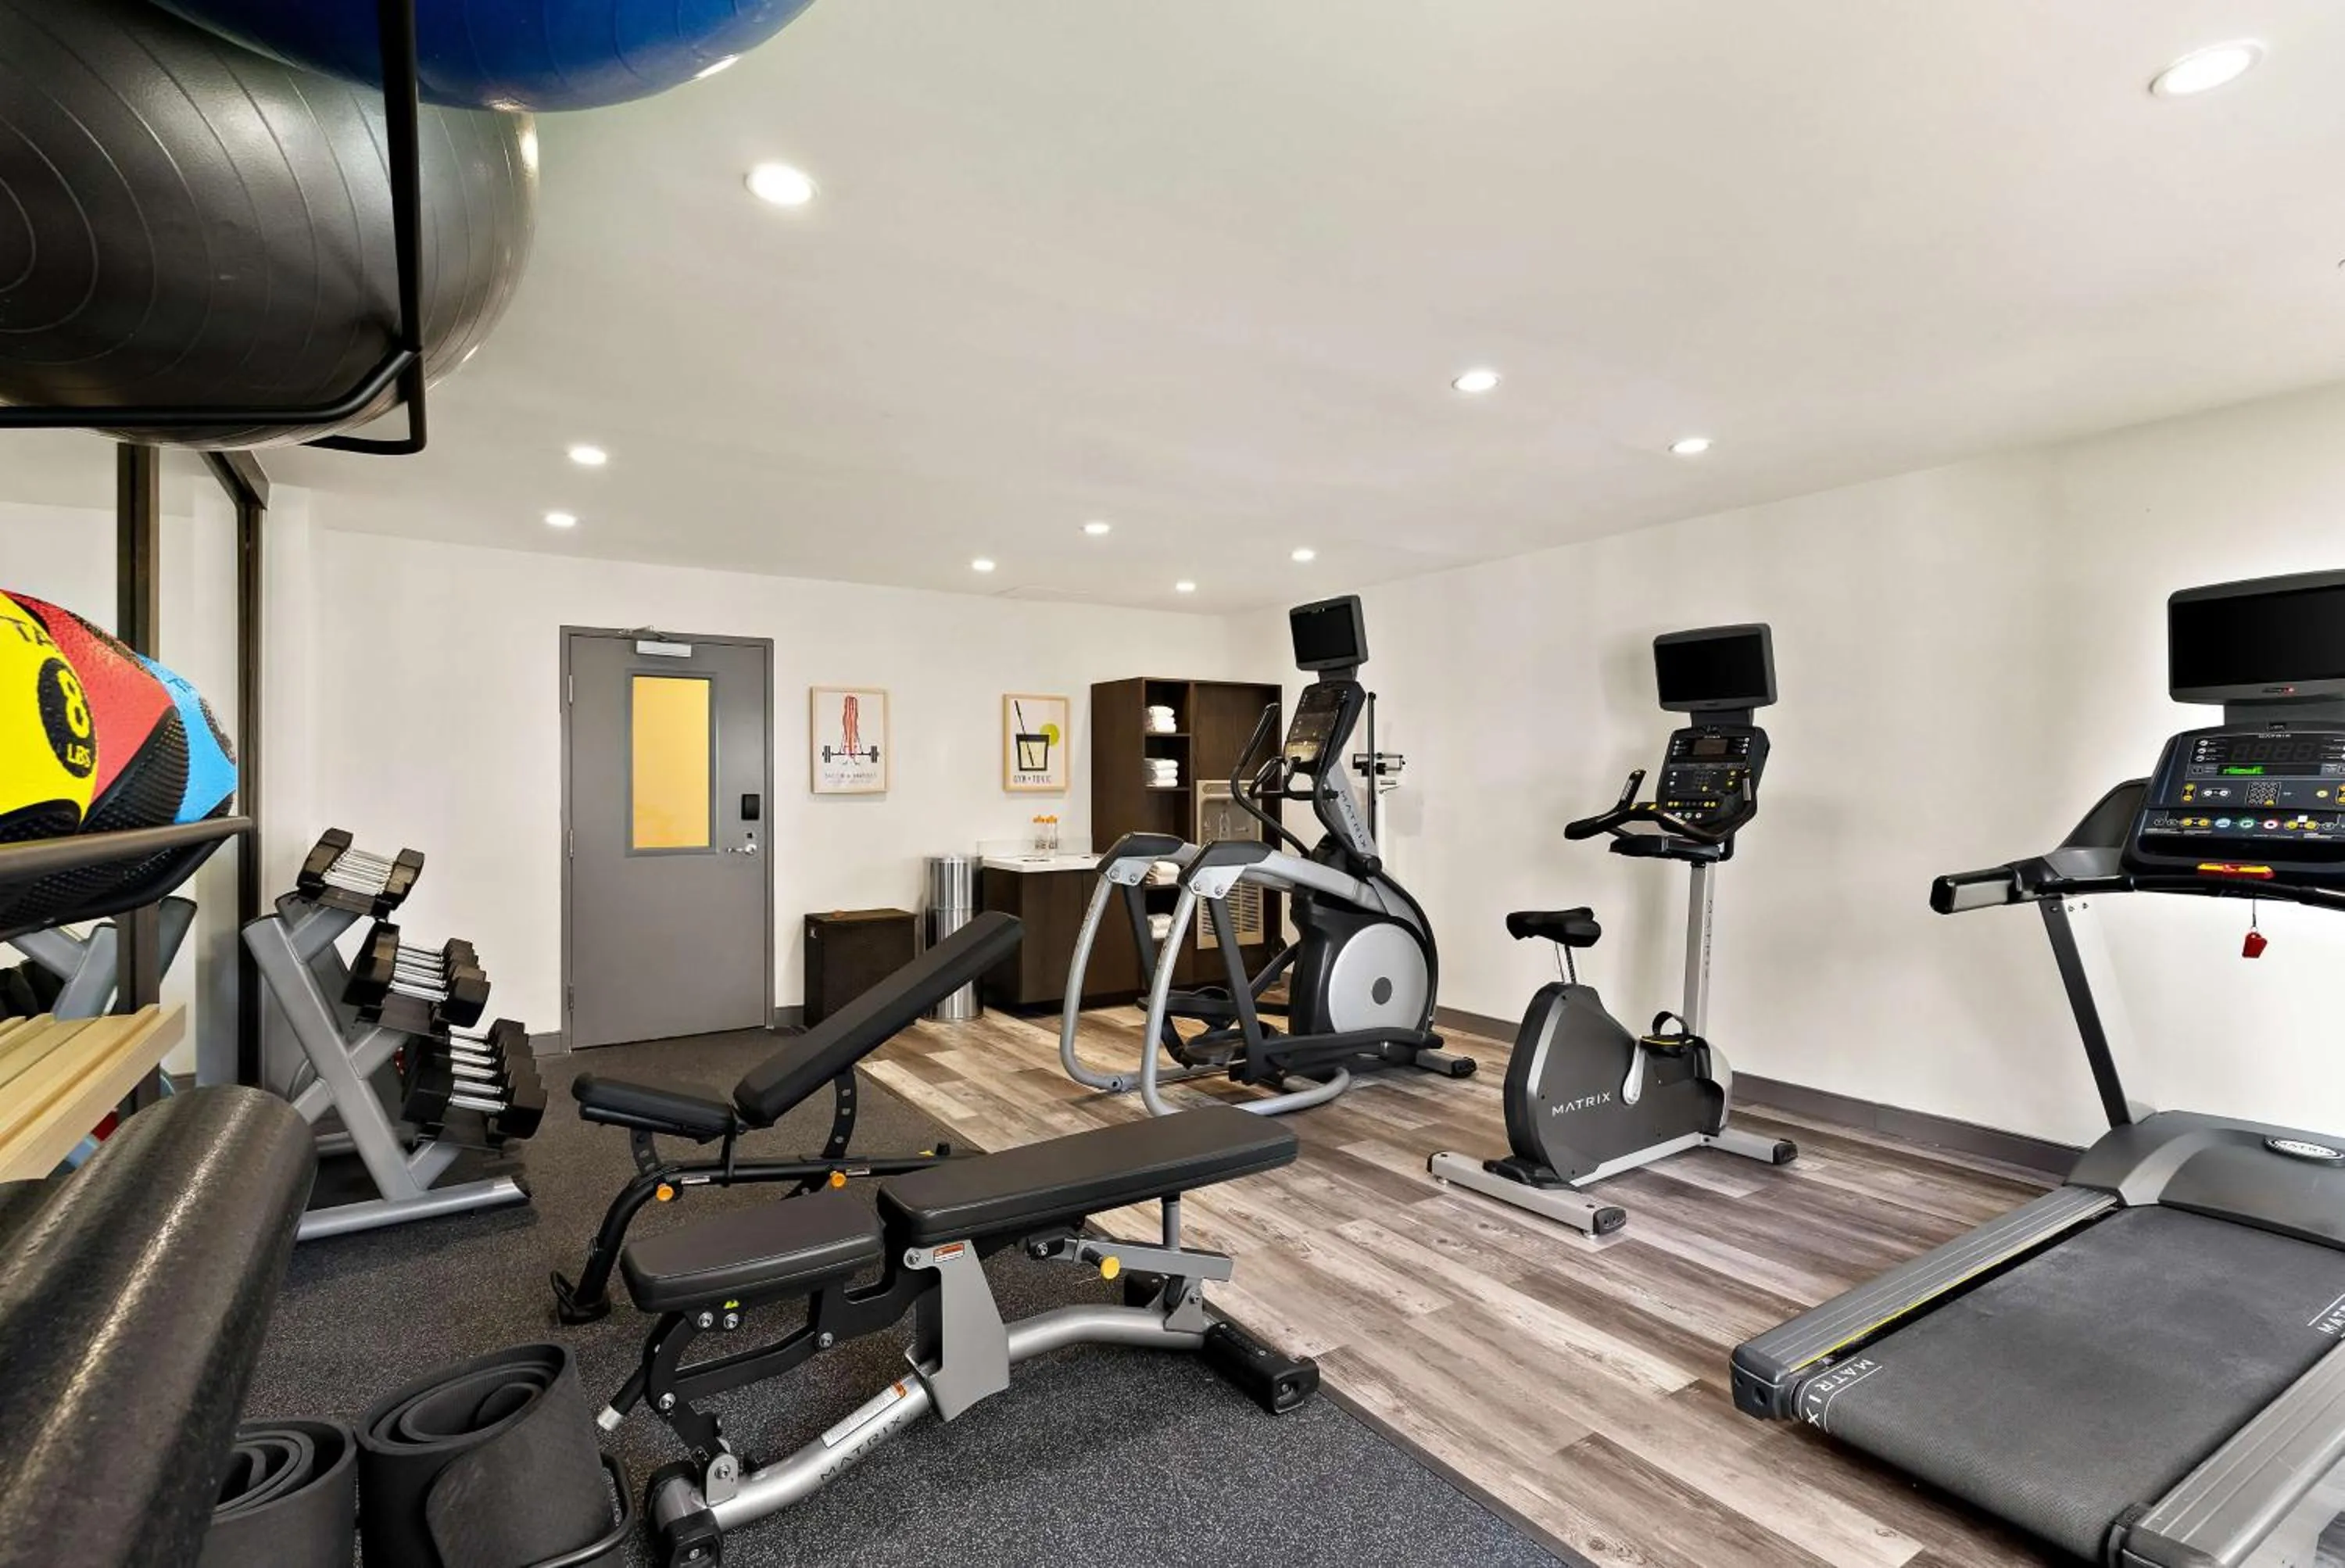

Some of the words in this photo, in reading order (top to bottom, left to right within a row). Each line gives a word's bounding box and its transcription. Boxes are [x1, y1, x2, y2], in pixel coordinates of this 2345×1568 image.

[56, 669, 90, 739] 8
[67, 743, 91, 768] LBS
[1552, 1091, 1610, 1117] MATRIX
[1806, 1359, 1875, 1428] MATRIX
[820, 1414, 901, 1483] MATRIX
